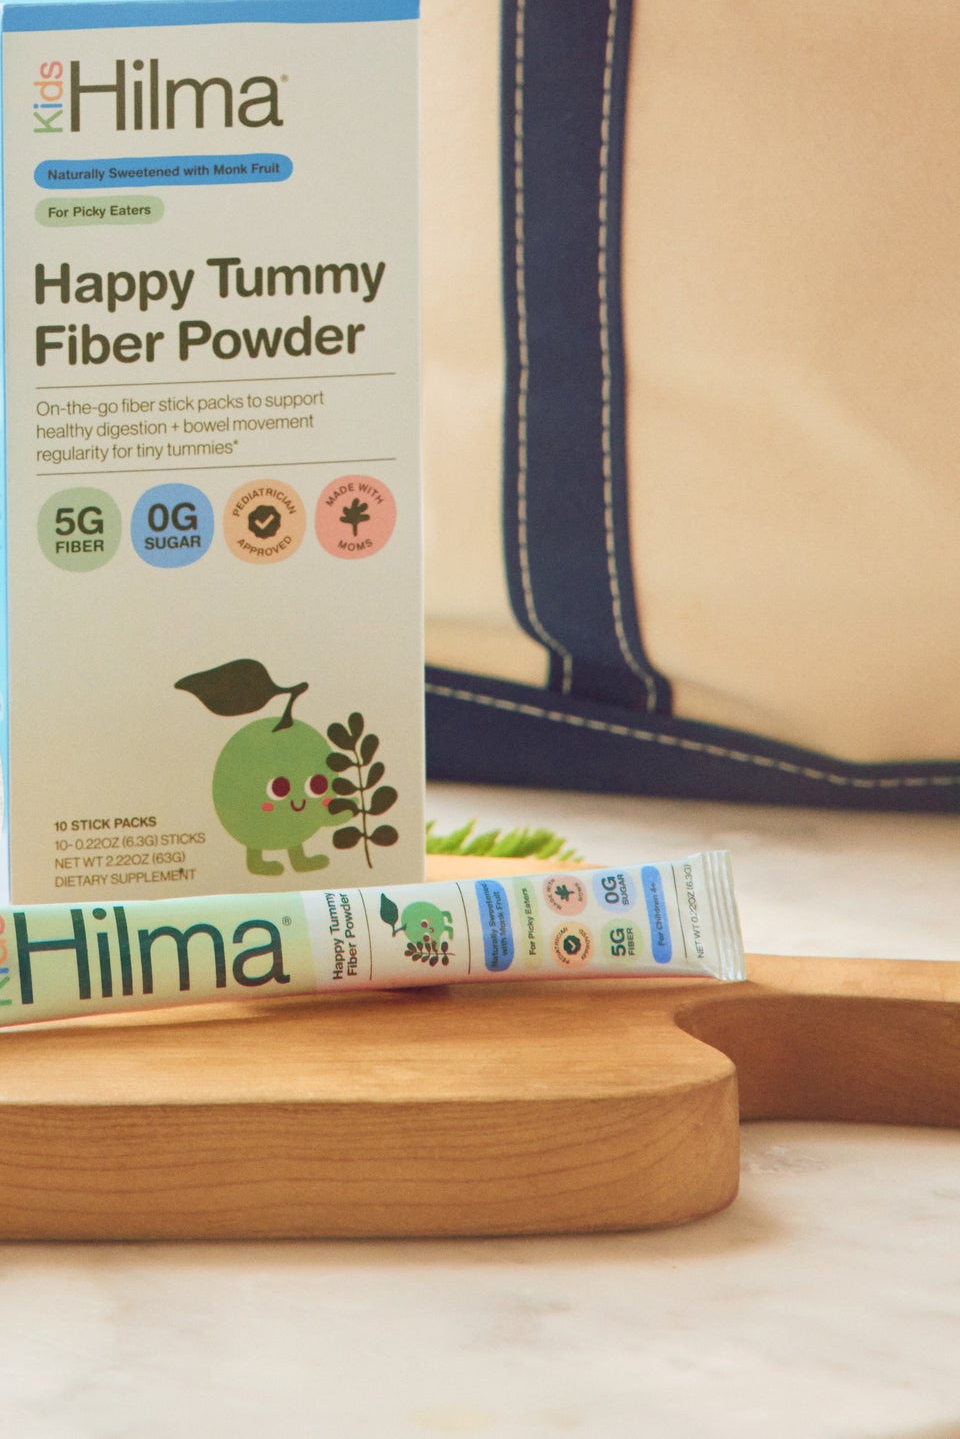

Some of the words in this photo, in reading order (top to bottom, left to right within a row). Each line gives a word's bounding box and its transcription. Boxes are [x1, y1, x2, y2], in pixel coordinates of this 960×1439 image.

[33, 60, 64, 134] Kids
[70, 58, 284, 133] Hilma
[47, 167, 105, 181] Naturally
[108, 165, 180, 179] Sweetened
[183, 164, 210, 177] with
[213, 164, 248, 176] Monk
[251, 162, 280, 175] Fruit
[48, 207, 69, 218] For
[73, 205, 106, 219] Picky
[110, 204, 152, 217] Eaters
[35, 262, 195, 313] Happy
[206, 257, 386, 303] Tummy
[35, 323, 165, 367] Fiber
[179, 315, 366, 362] Powder
[36, 399, 119, 418] On-the-go
[121, 398, 156, 413] fiber
[158, 396, 195, 412] stick
[197, 394, 244, 413] packs
[247, 394, 263, 408] to
[265, 391, 325, 409] support
[36, 423, 93, 441] healthy
[96, 420, 167, 439] digestion
[171, 424, 180, 433] +
[183, 417, 230, 434] bowel
[232, 414, 315, 432] movement
[36, 445, 109, 465] regularity
[112, 443, 134, 460] for
[136, 443, 164, 461] tiny
[232, 487, 297, 518] PEDIATRICIAN
[325, 482, 356, 507] MADE
[358, 482, 385, 505] WITH
[54, 507, 105, 536] 5G
[147, 502, 198, 533] 0G
[55, 539, 105, 553] FIBER
[144, 535, 202, 550] SUGAR
[236, 535, 292, 557] APPROVED
[337, 538, 374, 552] MOMS
[54, 821, 68, 832] 10
[71, 819, 110, 831] STICK
[114, 816, 157, 829] PACKS
[75, 837, 119, 850] 0.22OZ
[122, 834, 158, 848] (6.3G)
[160, 832, 206, 845] STICKS
[54, 857, 80, 869] NET
[83, 856, 103, 868] WT
[105, 853, 150, 867] 2.22OZ
[152, 851, 186, 864] (63G)
[54, 874, 108, 888] DIETARY
[110, 868, 197, 884] SUPPLEMENT
[601, 875, 620, 905] 0G
[617, 874, 630, 906] SUGAR
[683, 863, 694, 890] (6.3G)
[324, 892, 340, 935] Tummy
[493, 891, 503, 911] Fruit
[521, 888, 532, 915] Eaters
[651, 894, 663, 930] Children
[339, 892, 355, 939] Powder
[526, 916, 535, 939] Picky
[609, 928, 626, 957] 5G
[626, 927, 635, 956] FIBER
[657, 932, 665, 946] For
[692, 924, 701, 939] WT
[13, 906, 290, 1005] Hilma
[332, 938, 346, 980] Happy
[347, 941, 358, 976] Fiber
[500, 937, 508, 956] with
[528, 940, 537, 956] For
[694, 940, 705, 959] NET
